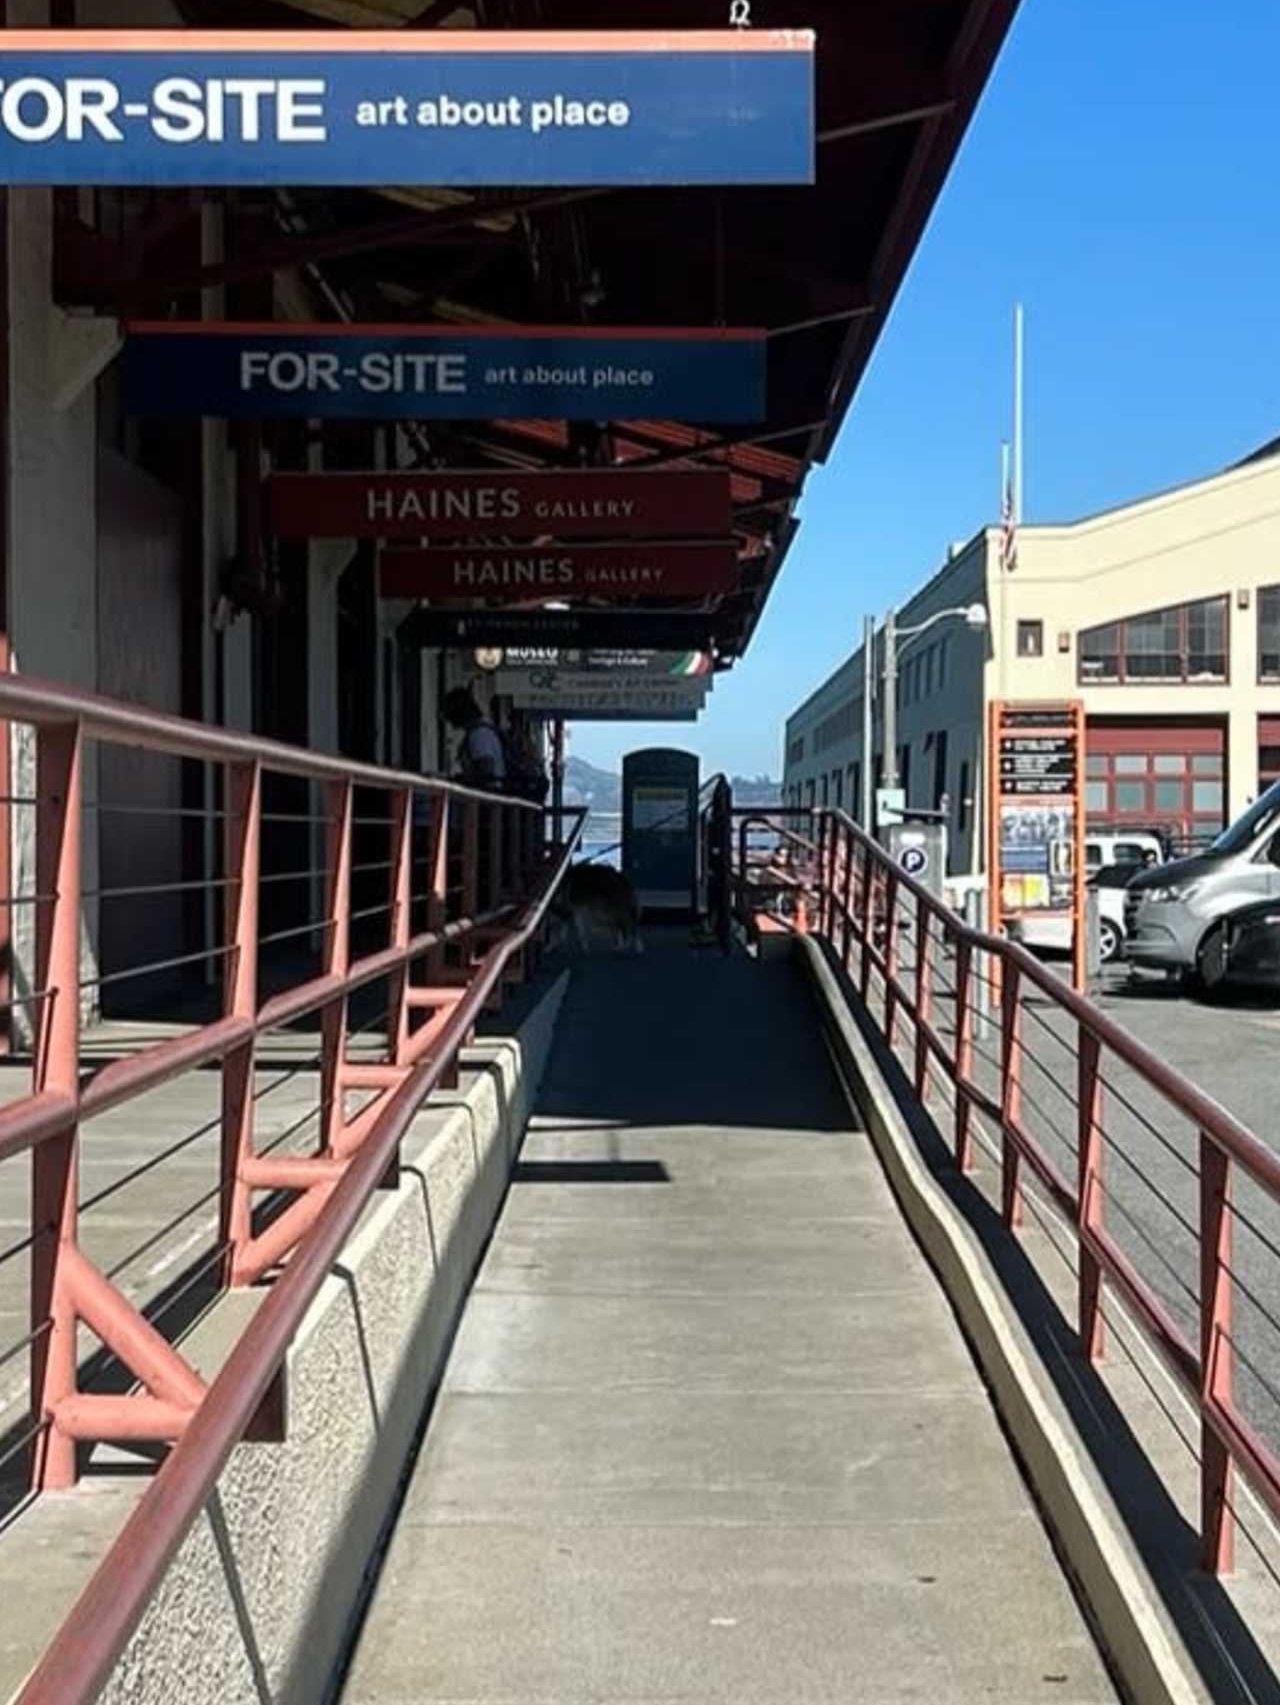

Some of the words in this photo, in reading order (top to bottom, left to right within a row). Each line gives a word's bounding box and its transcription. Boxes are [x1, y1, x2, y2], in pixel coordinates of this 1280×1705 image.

[356, 99, 408, 127] art
[417, 95, 523, 127] about
[531, 95, 630, 132] place
[239, 350, 468, 394] FOR-SITE
[484, 366, 518, 386] art
[522, 364, 588, 386] about
[592, 365, 654, 390] place
[365, 488, 521, 521] HAINES
[533, 499, 636, 518] GALLERY
[453, 558, 575, 586] HAINES
[584, 567, 665, 583] GALLERY
